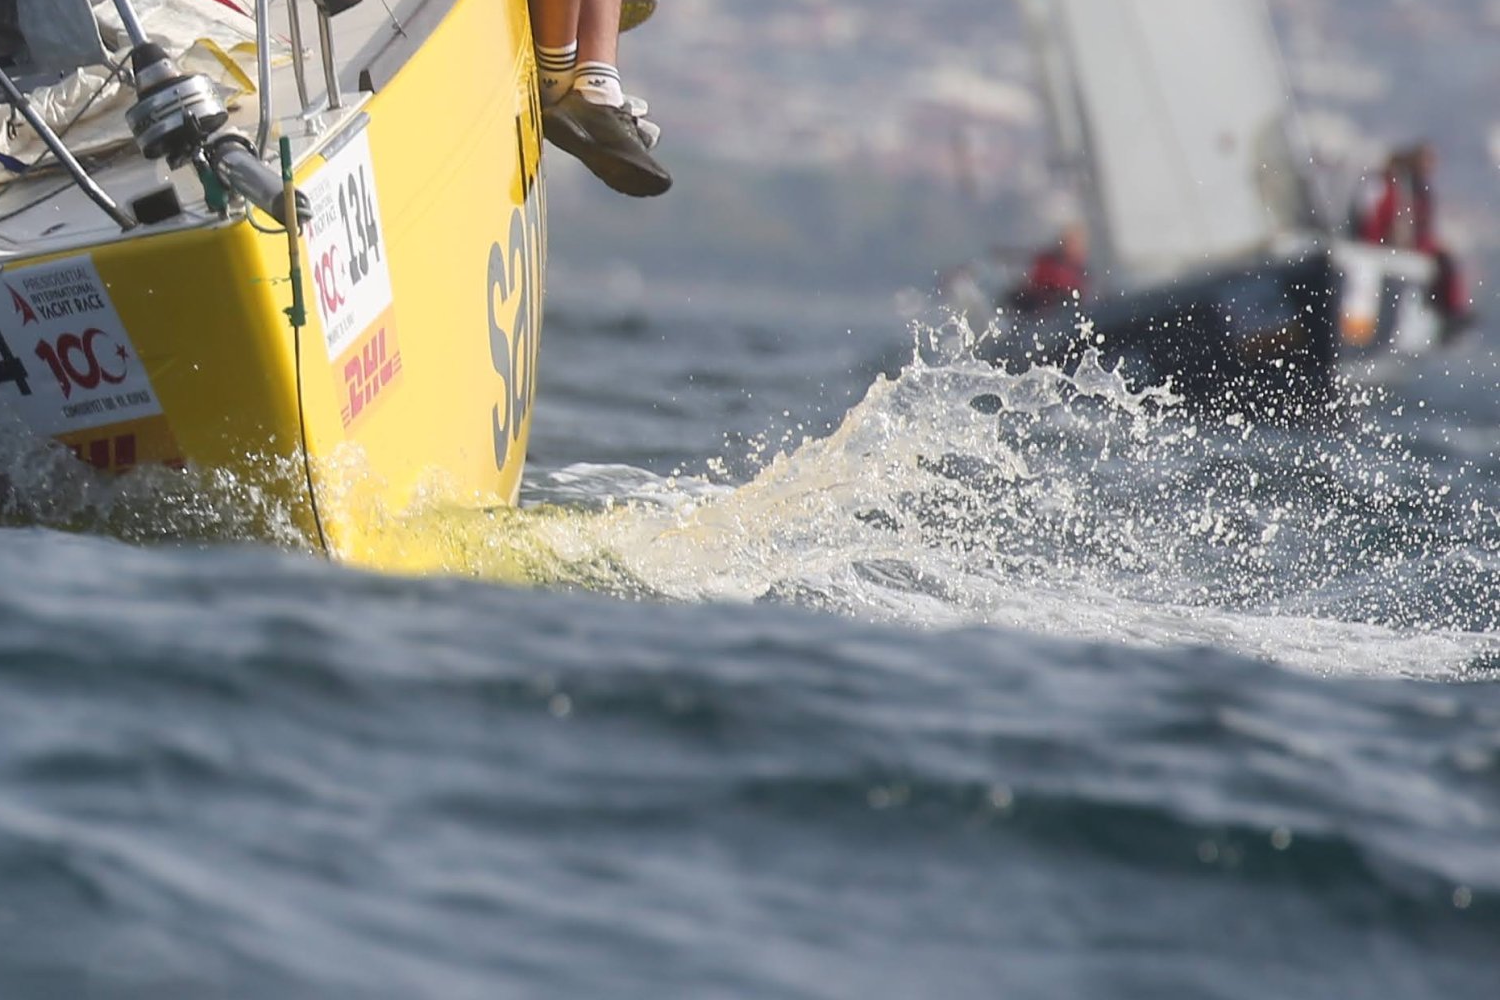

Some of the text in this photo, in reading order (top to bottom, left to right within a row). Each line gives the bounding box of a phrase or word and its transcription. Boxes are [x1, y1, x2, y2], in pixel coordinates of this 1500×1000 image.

[338, 164, 380, 287] 134
[36, 293, 106, 320] YACHT RACE
[343, 326, 394, 420] DHL
